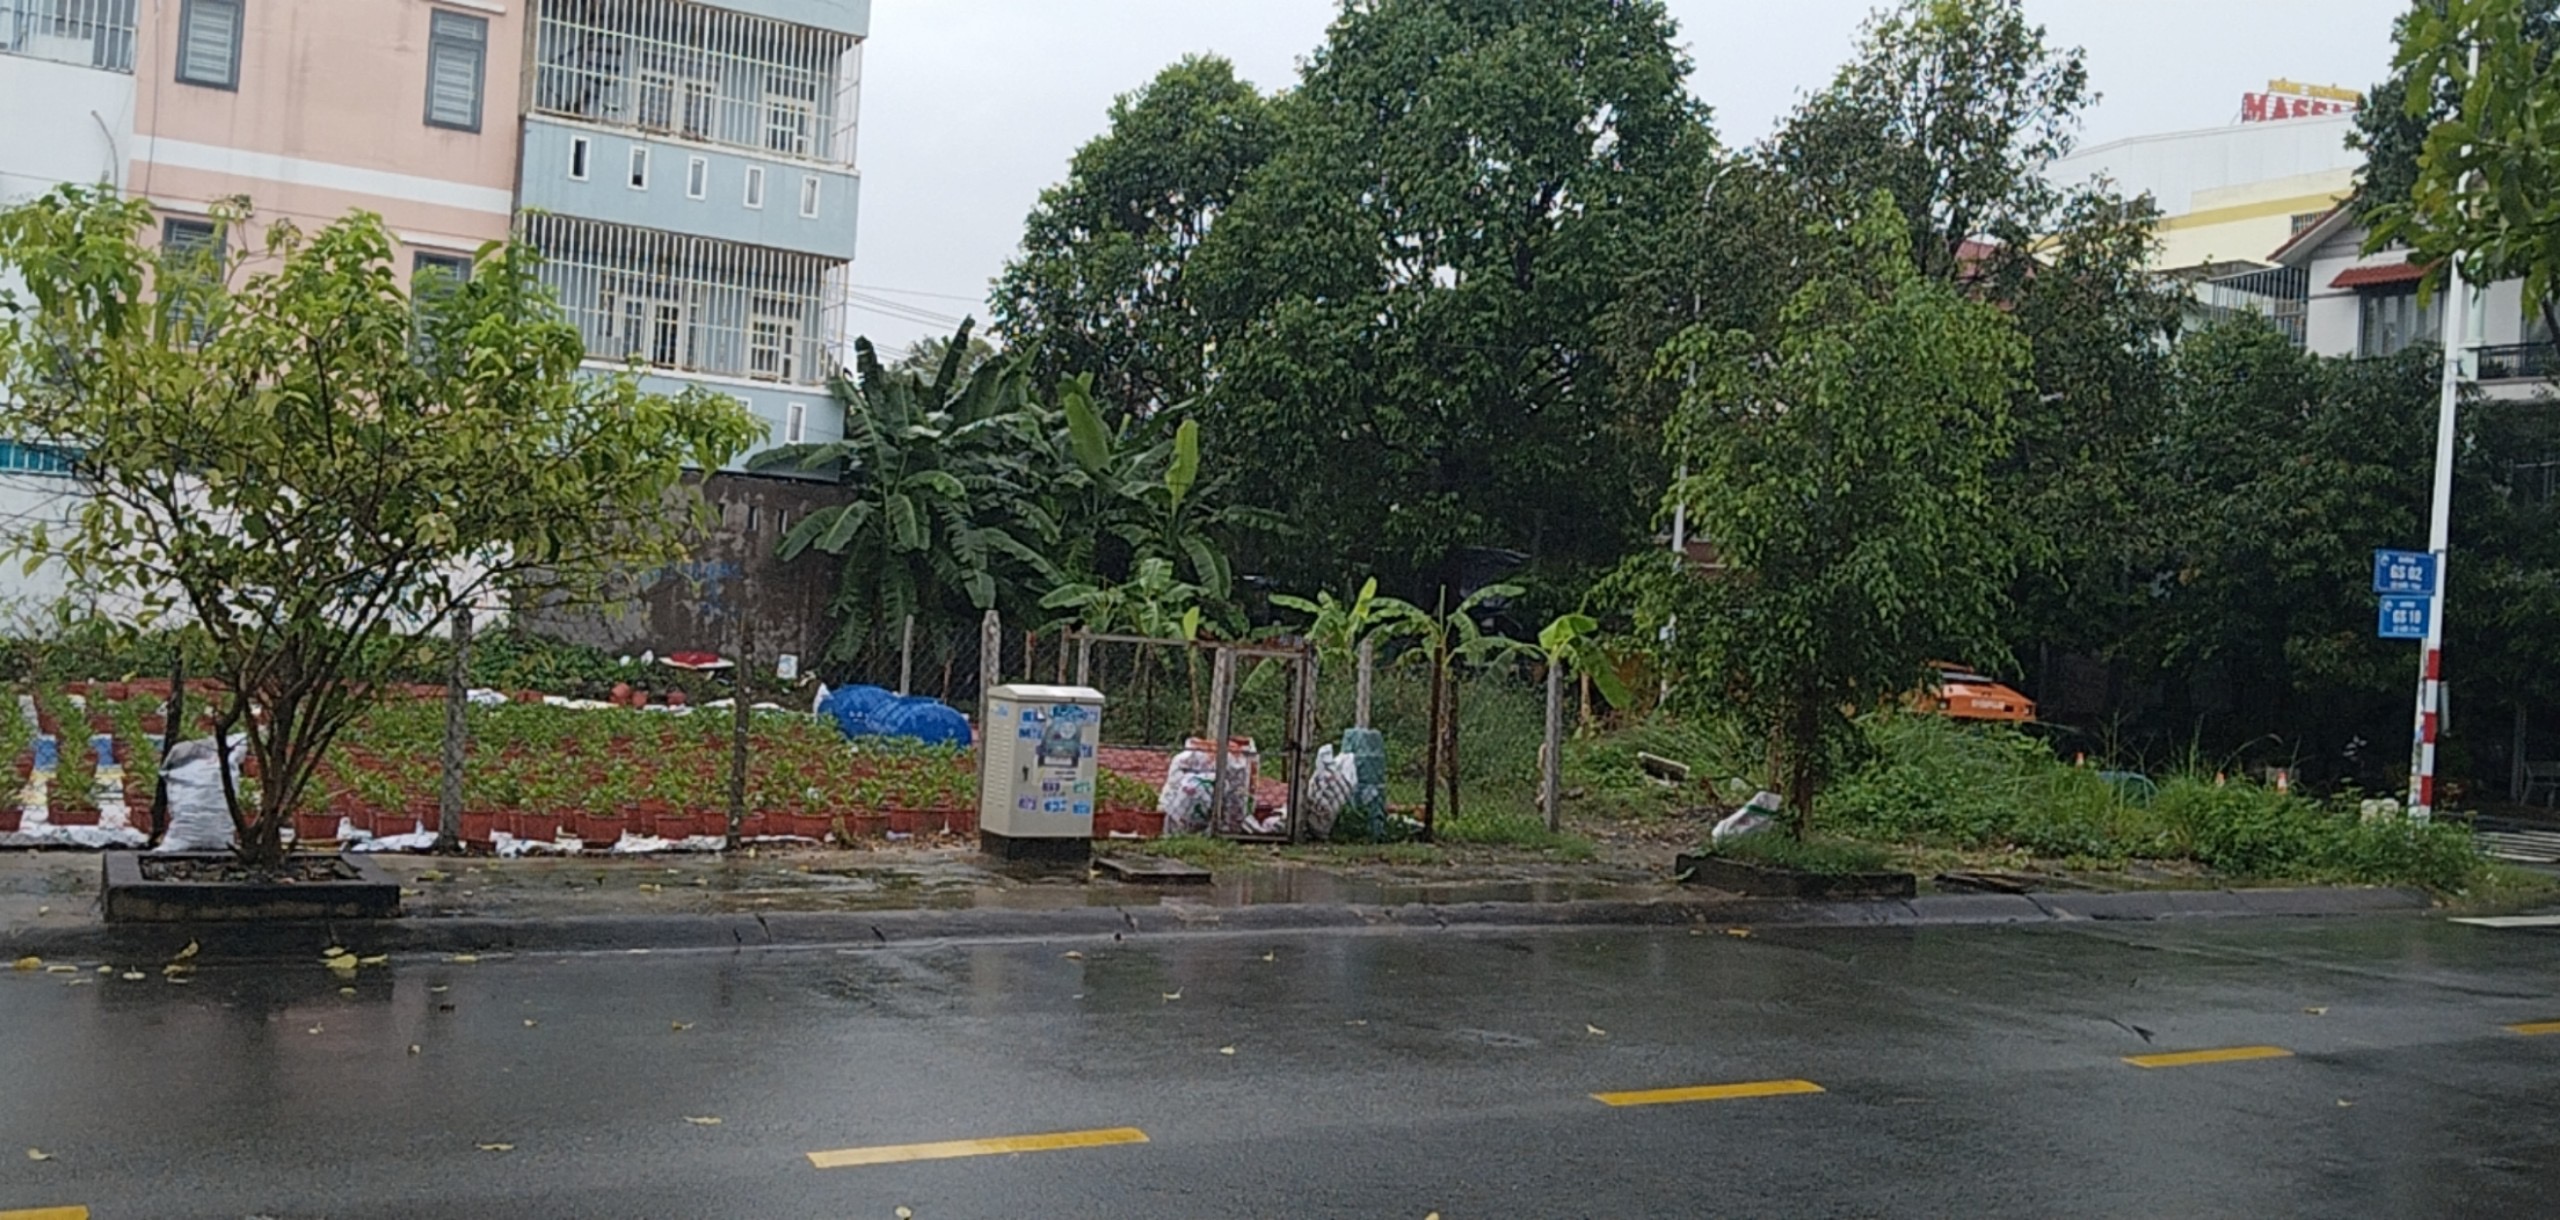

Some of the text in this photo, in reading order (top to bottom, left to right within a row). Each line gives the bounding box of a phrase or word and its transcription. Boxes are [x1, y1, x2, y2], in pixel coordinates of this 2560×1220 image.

[2242, 93, 2352, 122] MASSA
[2390, 564, 2422, 581] GS 02
[2392, 610, 2407, 624] GS
